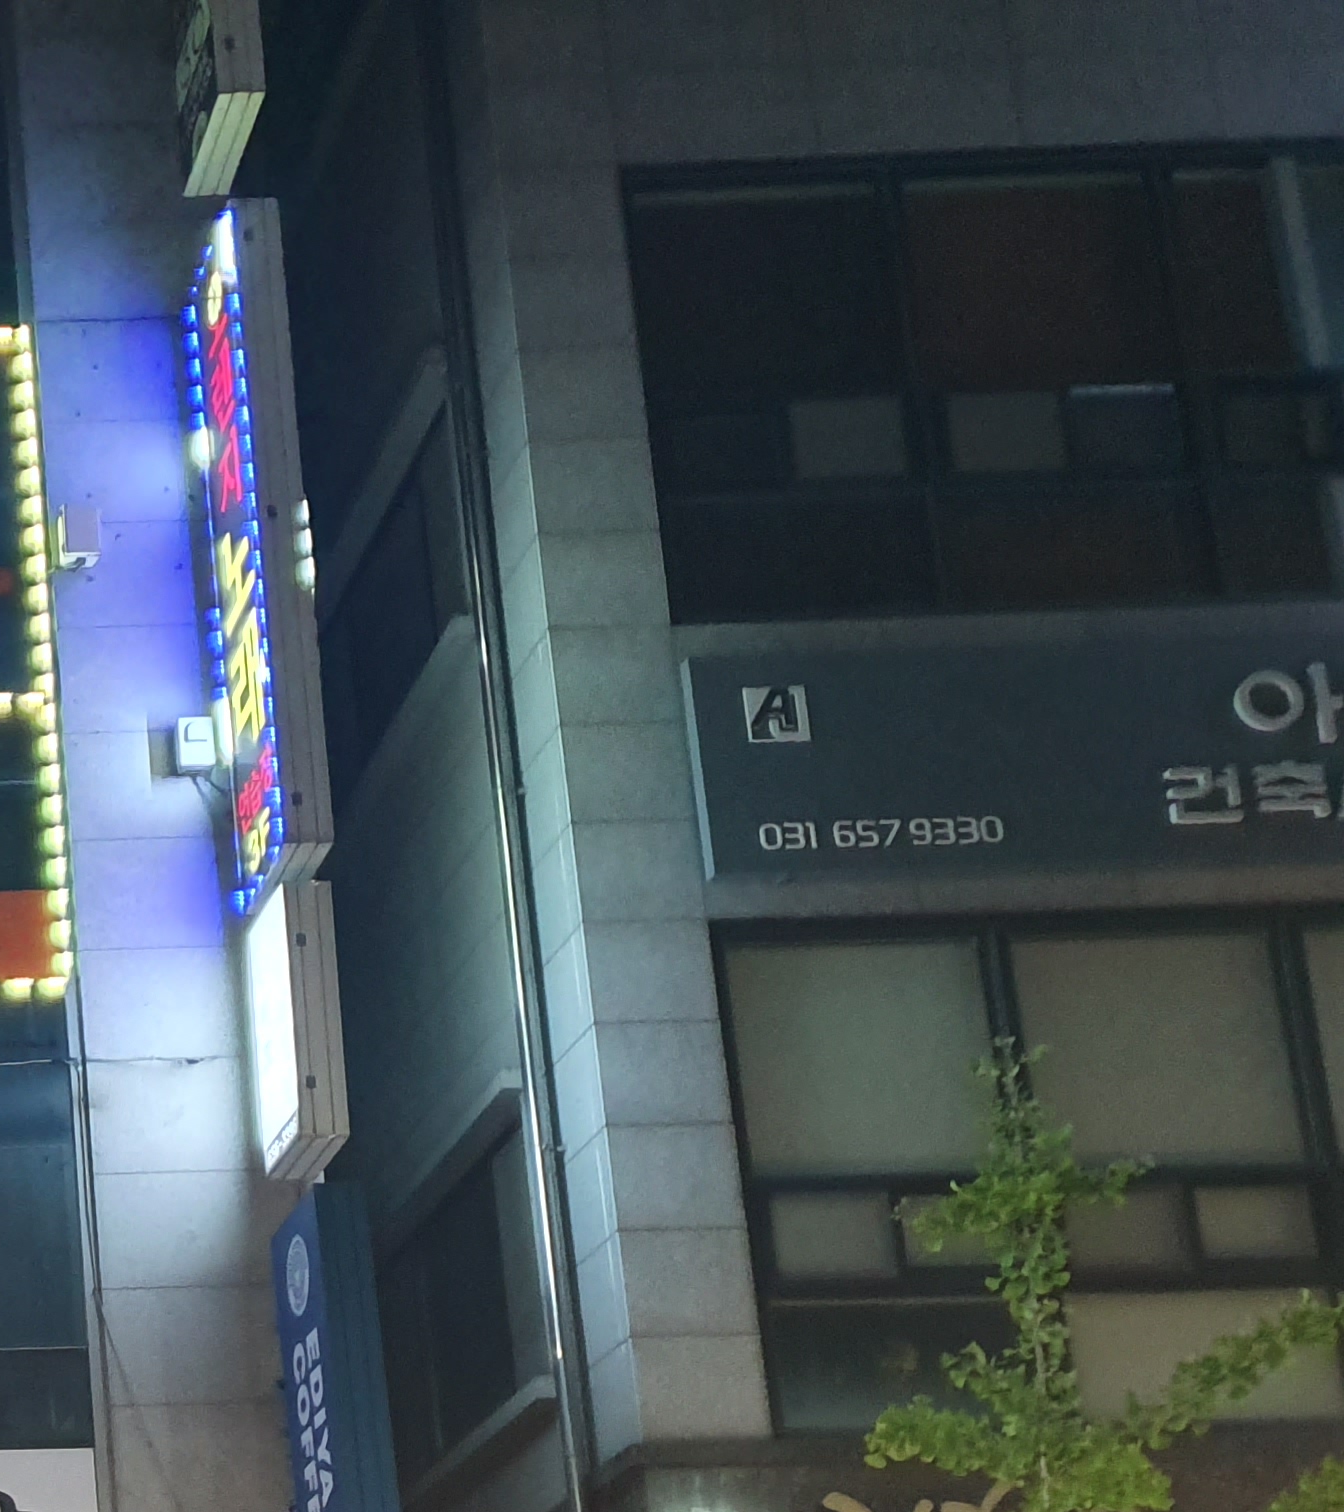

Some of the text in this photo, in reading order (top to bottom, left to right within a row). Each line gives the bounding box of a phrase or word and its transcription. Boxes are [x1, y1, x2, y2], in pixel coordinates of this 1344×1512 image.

[1162, 759, 1344, 825] 건축
[758, 815, 1005, 851] 031 657 9330
[305, 1326, 336, 1509] EDIYA
